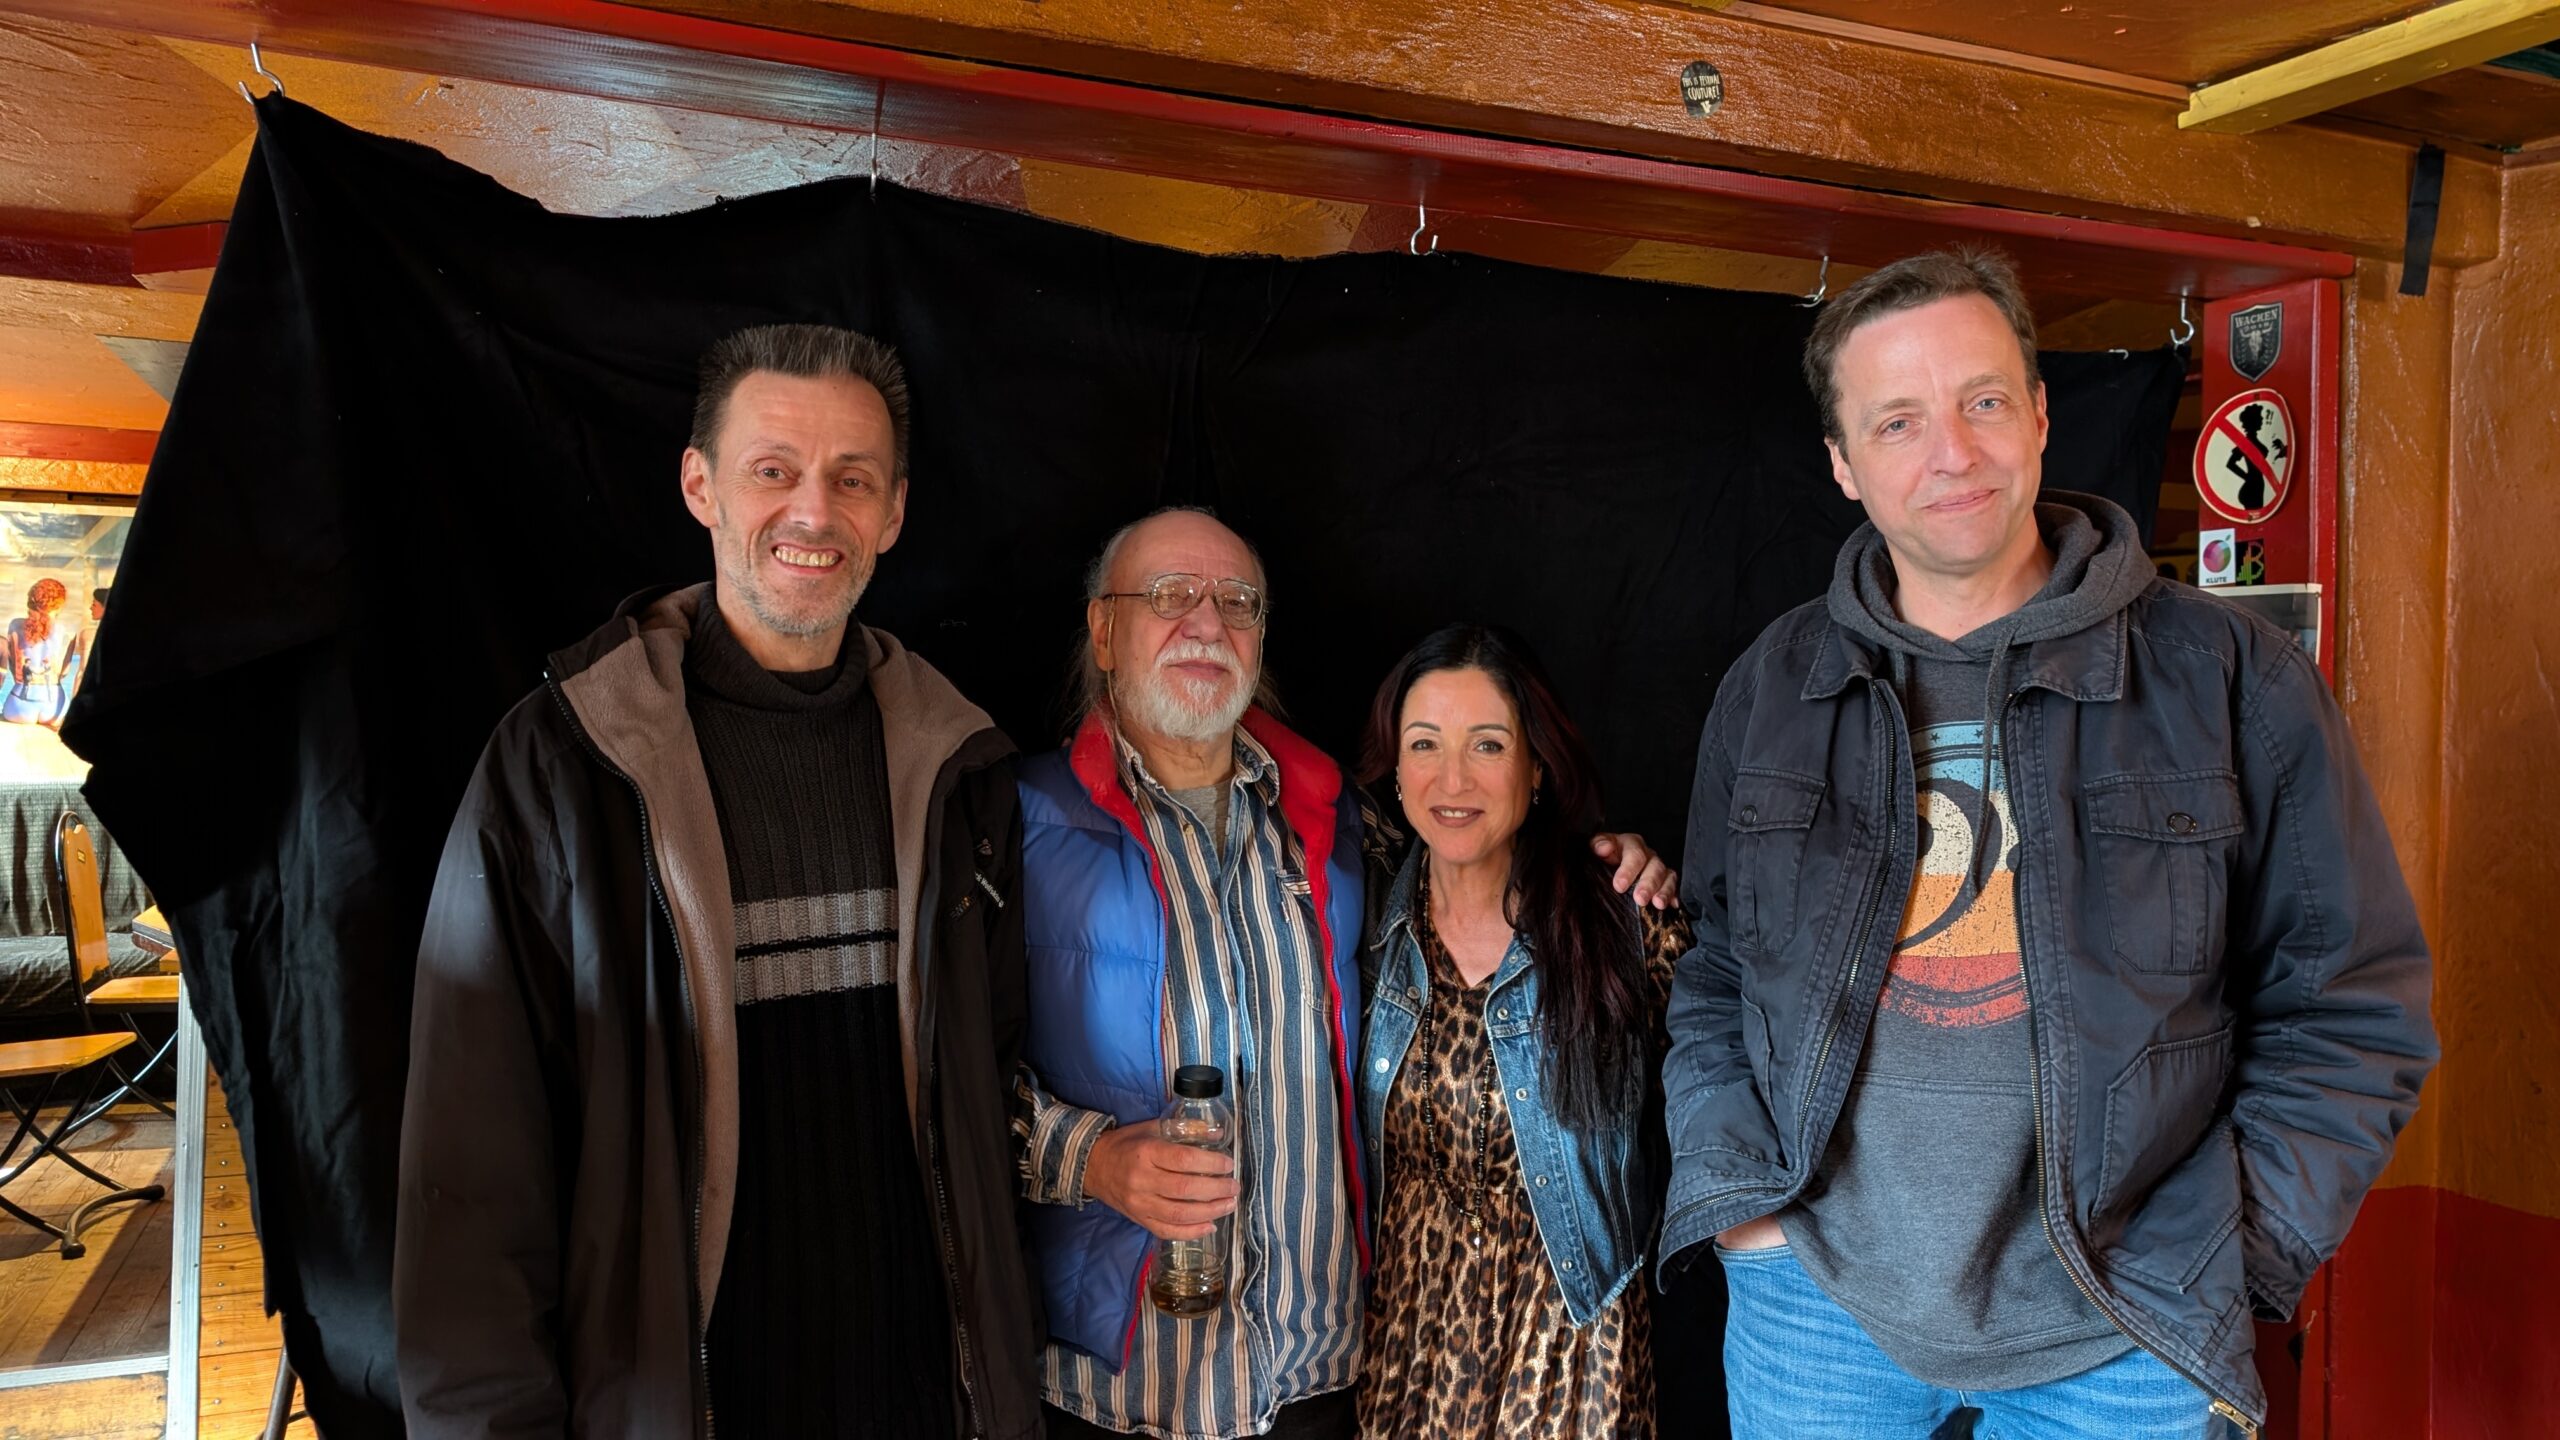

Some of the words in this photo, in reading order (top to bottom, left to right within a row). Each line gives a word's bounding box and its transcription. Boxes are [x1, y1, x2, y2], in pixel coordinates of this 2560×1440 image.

[1682, 78, 1693, 87] THIS
[1693, 77, 1698, 85] IS
[1699, 74, 1720, 86] FESTIVAL
[1687, 86, 1720, 101] COUTURE!
[2235, 308, 2278, 328] WACKEN
[2205, 576, 2227, 584] KLUTE
